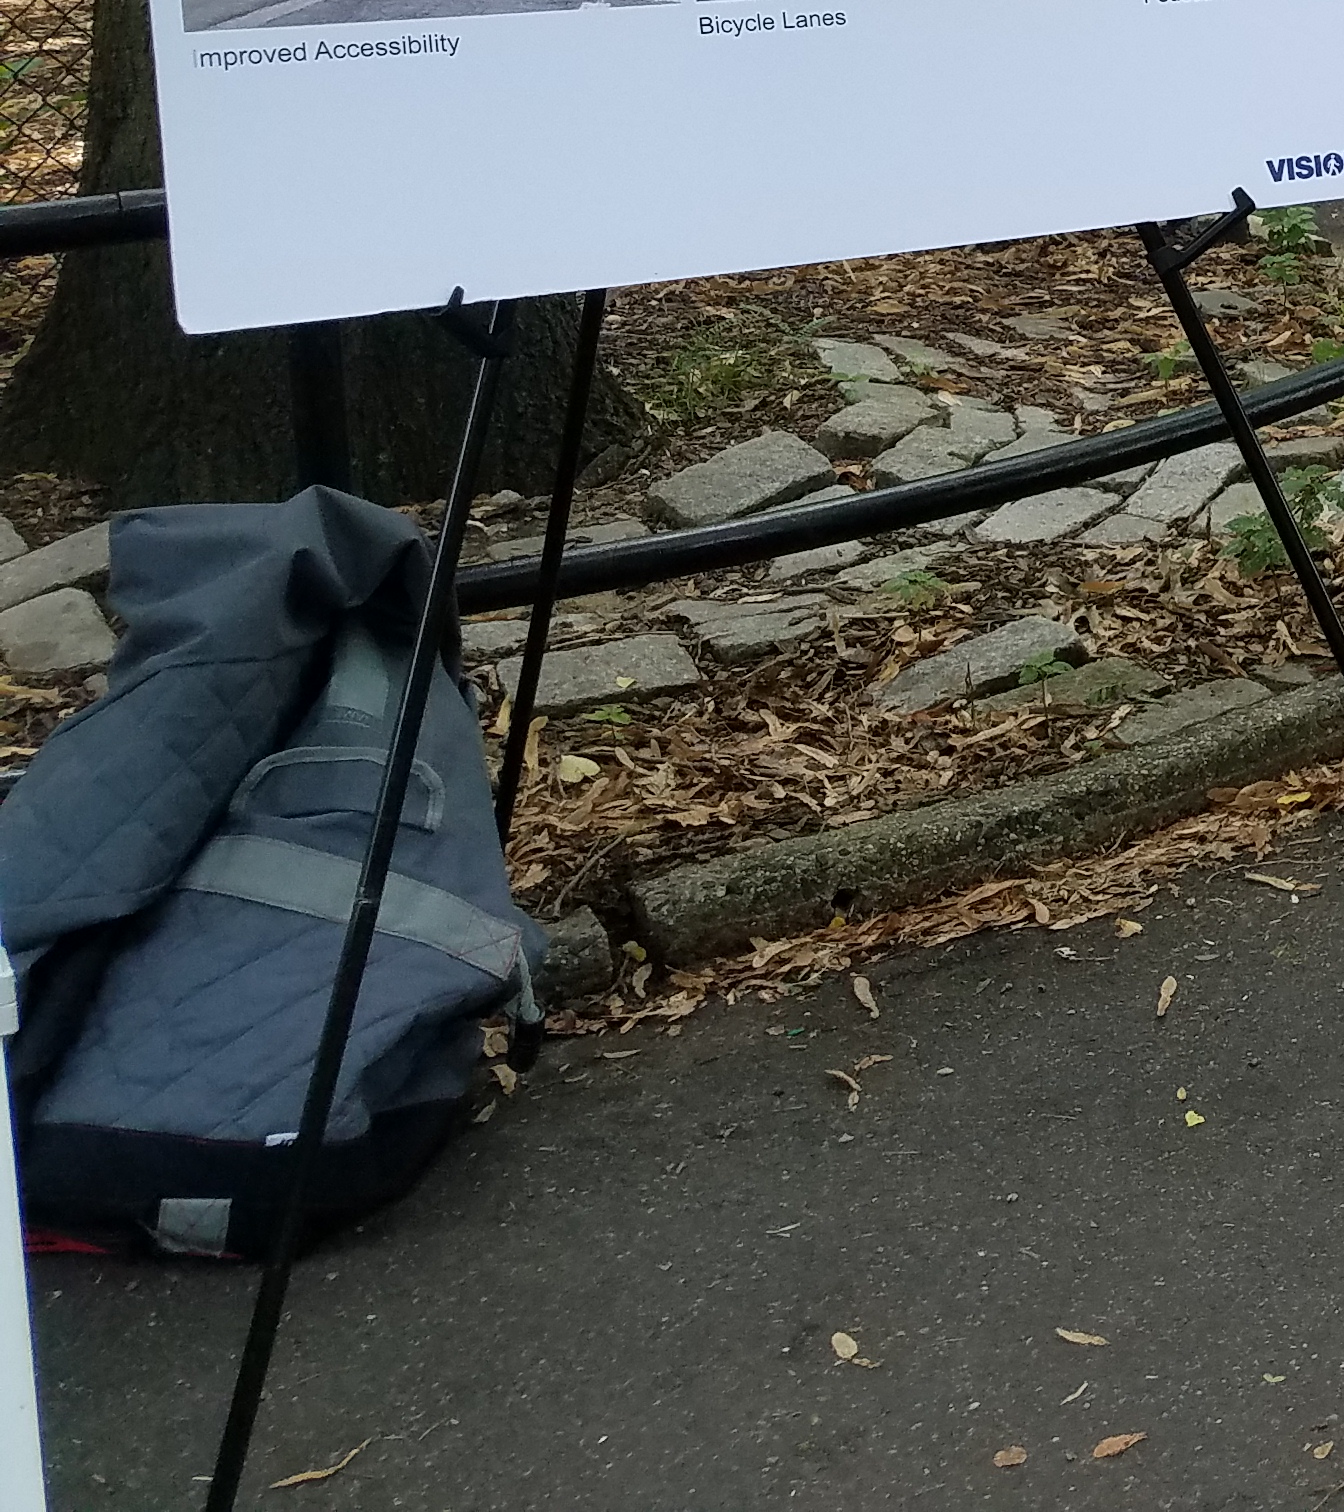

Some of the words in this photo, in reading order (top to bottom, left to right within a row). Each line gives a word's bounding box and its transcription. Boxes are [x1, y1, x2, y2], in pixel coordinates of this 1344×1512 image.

[699, 13, 774, 37] Bicycle
[782, 12, 846, 28] Lanes
[194, 42, 306, 70] Improved
[314, 34, 459, 60] Accessibility
